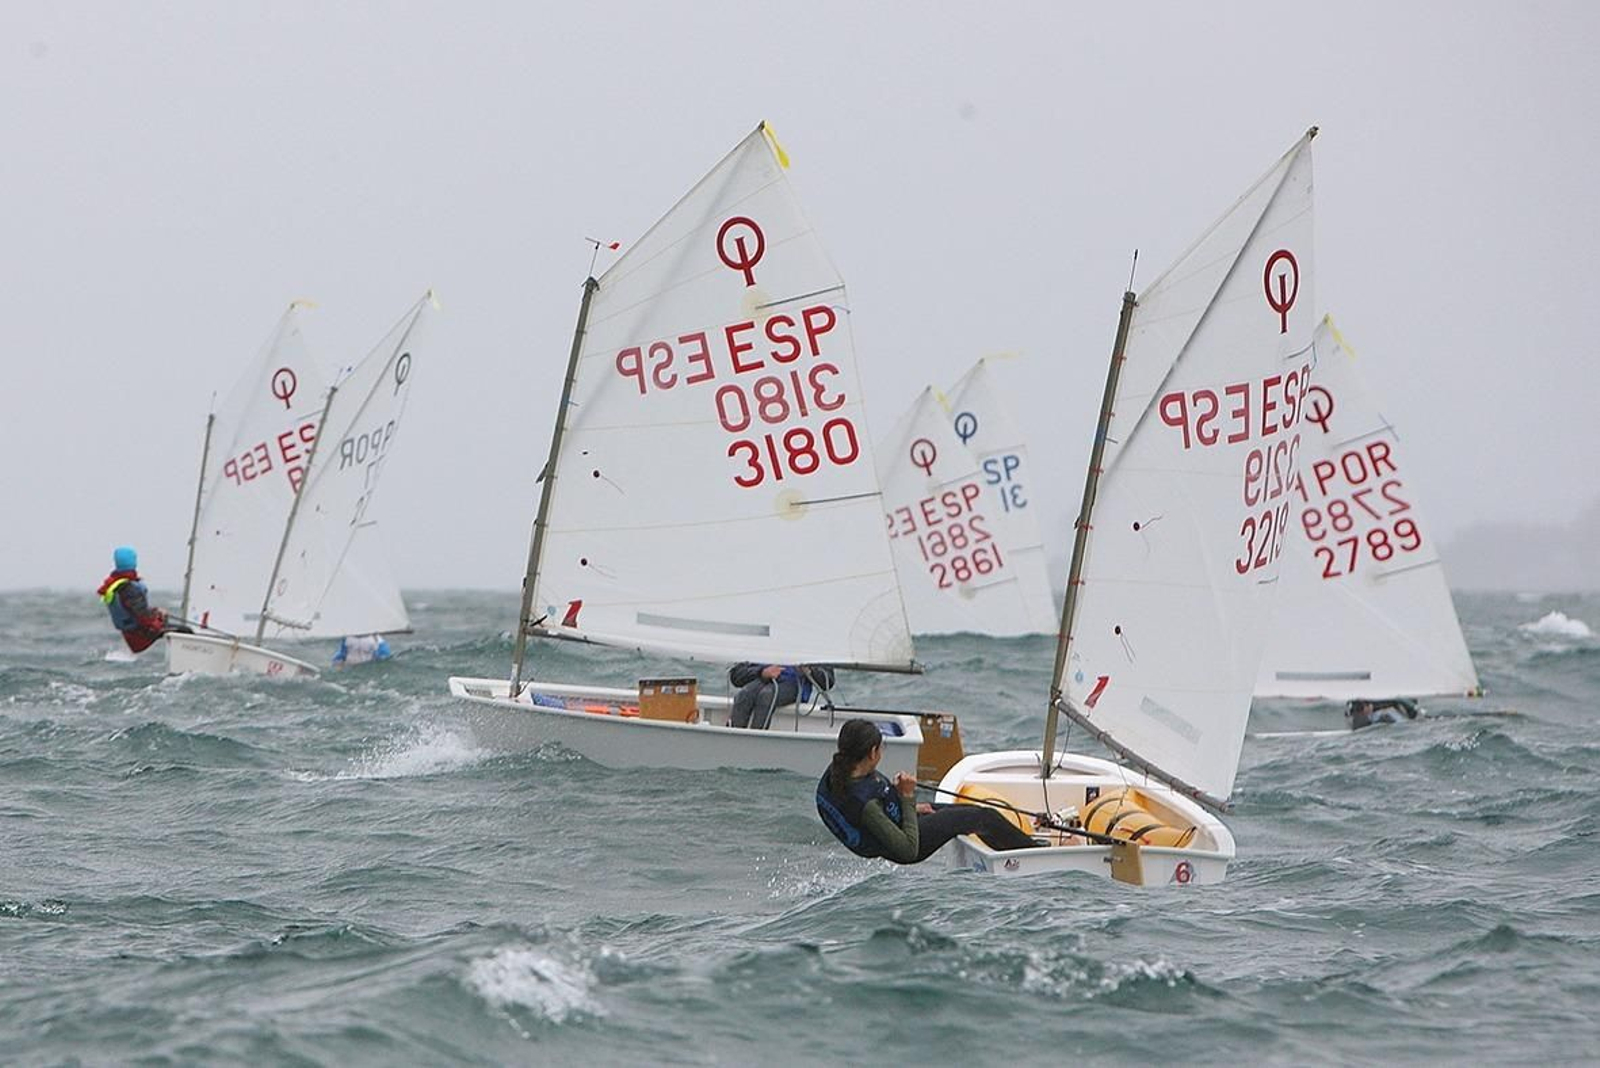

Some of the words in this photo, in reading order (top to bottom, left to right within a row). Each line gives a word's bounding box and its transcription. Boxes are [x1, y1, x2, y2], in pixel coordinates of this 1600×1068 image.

[725, 304, 836, 375] ESP
[1261, 363, 1311, 437] ESP
[277, 422, 315, 464] ES
[727, 417, 860, 488] 3180
[982, 455, 1021, 486] SP
[1312, 440, 1398, 497] POR
[919, 483, 980, 527] ESP
[929, 541, 1004, 590] 2861
[1235, 501, 1290, 575] 3219
[1313, 517, 1422, 580] 2789
